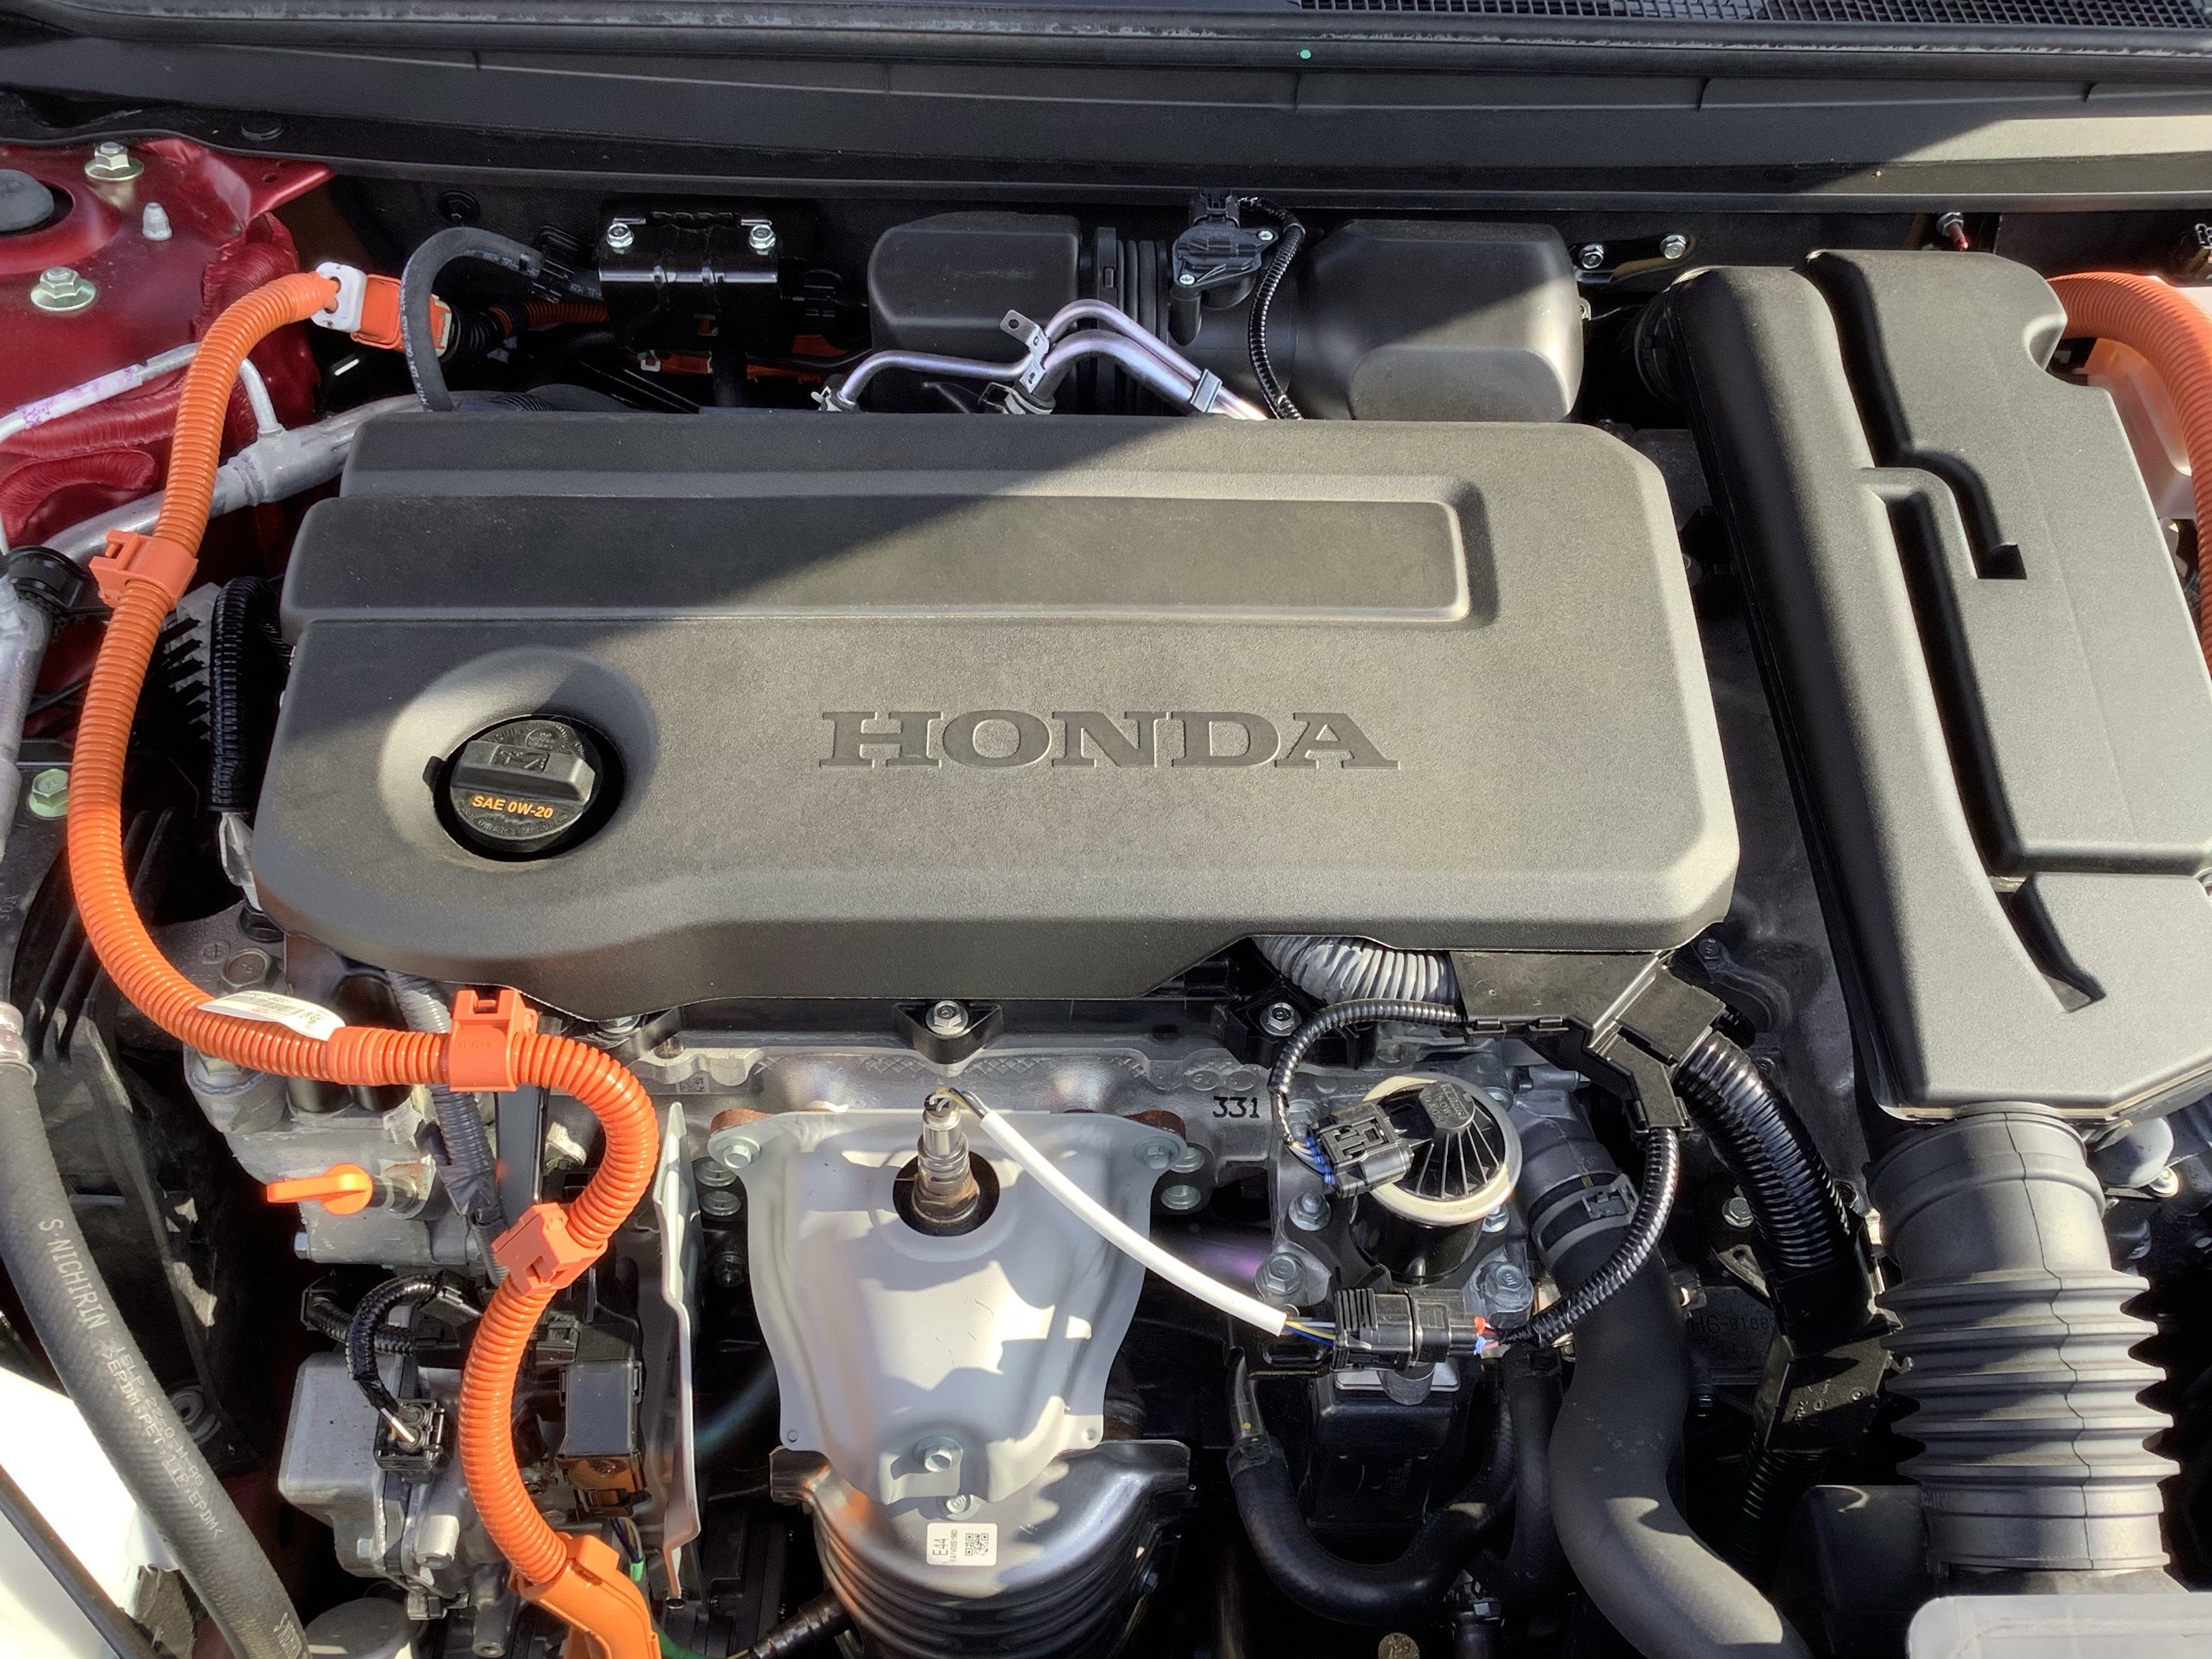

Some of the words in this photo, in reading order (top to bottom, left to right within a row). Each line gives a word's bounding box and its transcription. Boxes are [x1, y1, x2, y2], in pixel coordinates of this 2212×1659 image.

[819, 710, 1401, 770] HONDA
[472, 796, 506, 811] SAE
[508, 801, 554, 819] 0W-20
[1212, 1096, 1260, 1118] 331
[933, 1538, 948, 1556] E44
